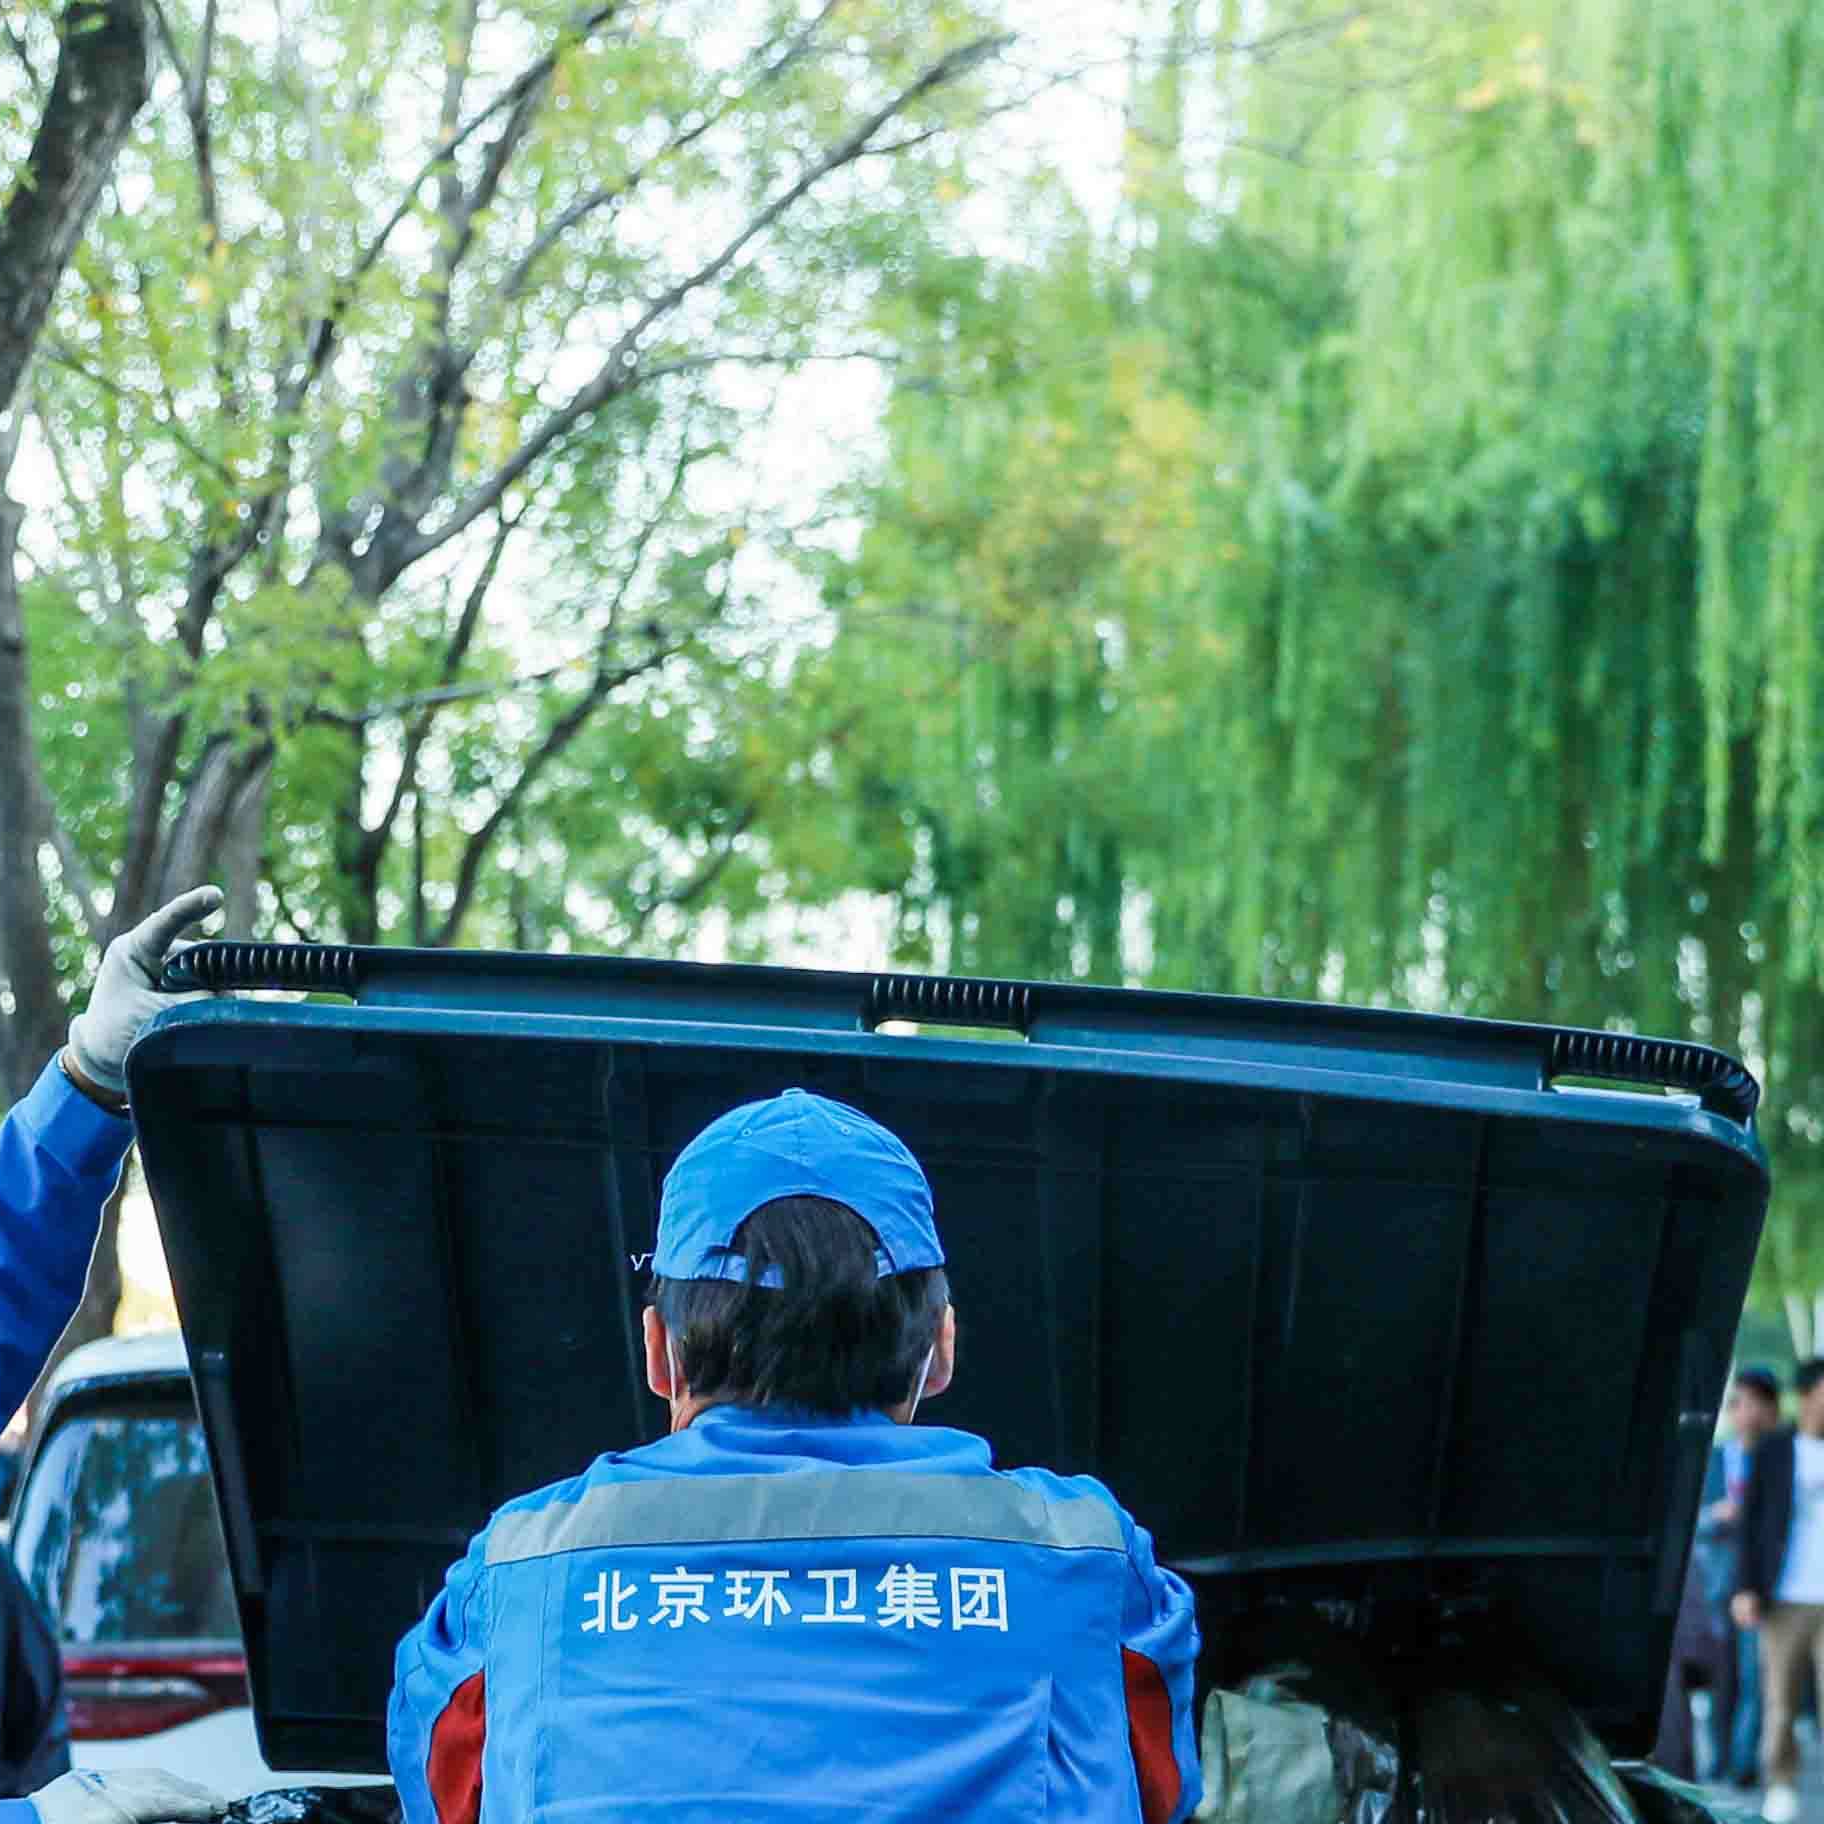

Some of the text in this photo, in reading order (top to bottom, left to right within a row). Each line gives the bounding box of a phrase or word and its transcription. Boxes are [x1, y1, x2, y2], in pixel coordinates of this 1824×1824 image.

[580, 1563, 1009, 1633] 北京环卫集团
